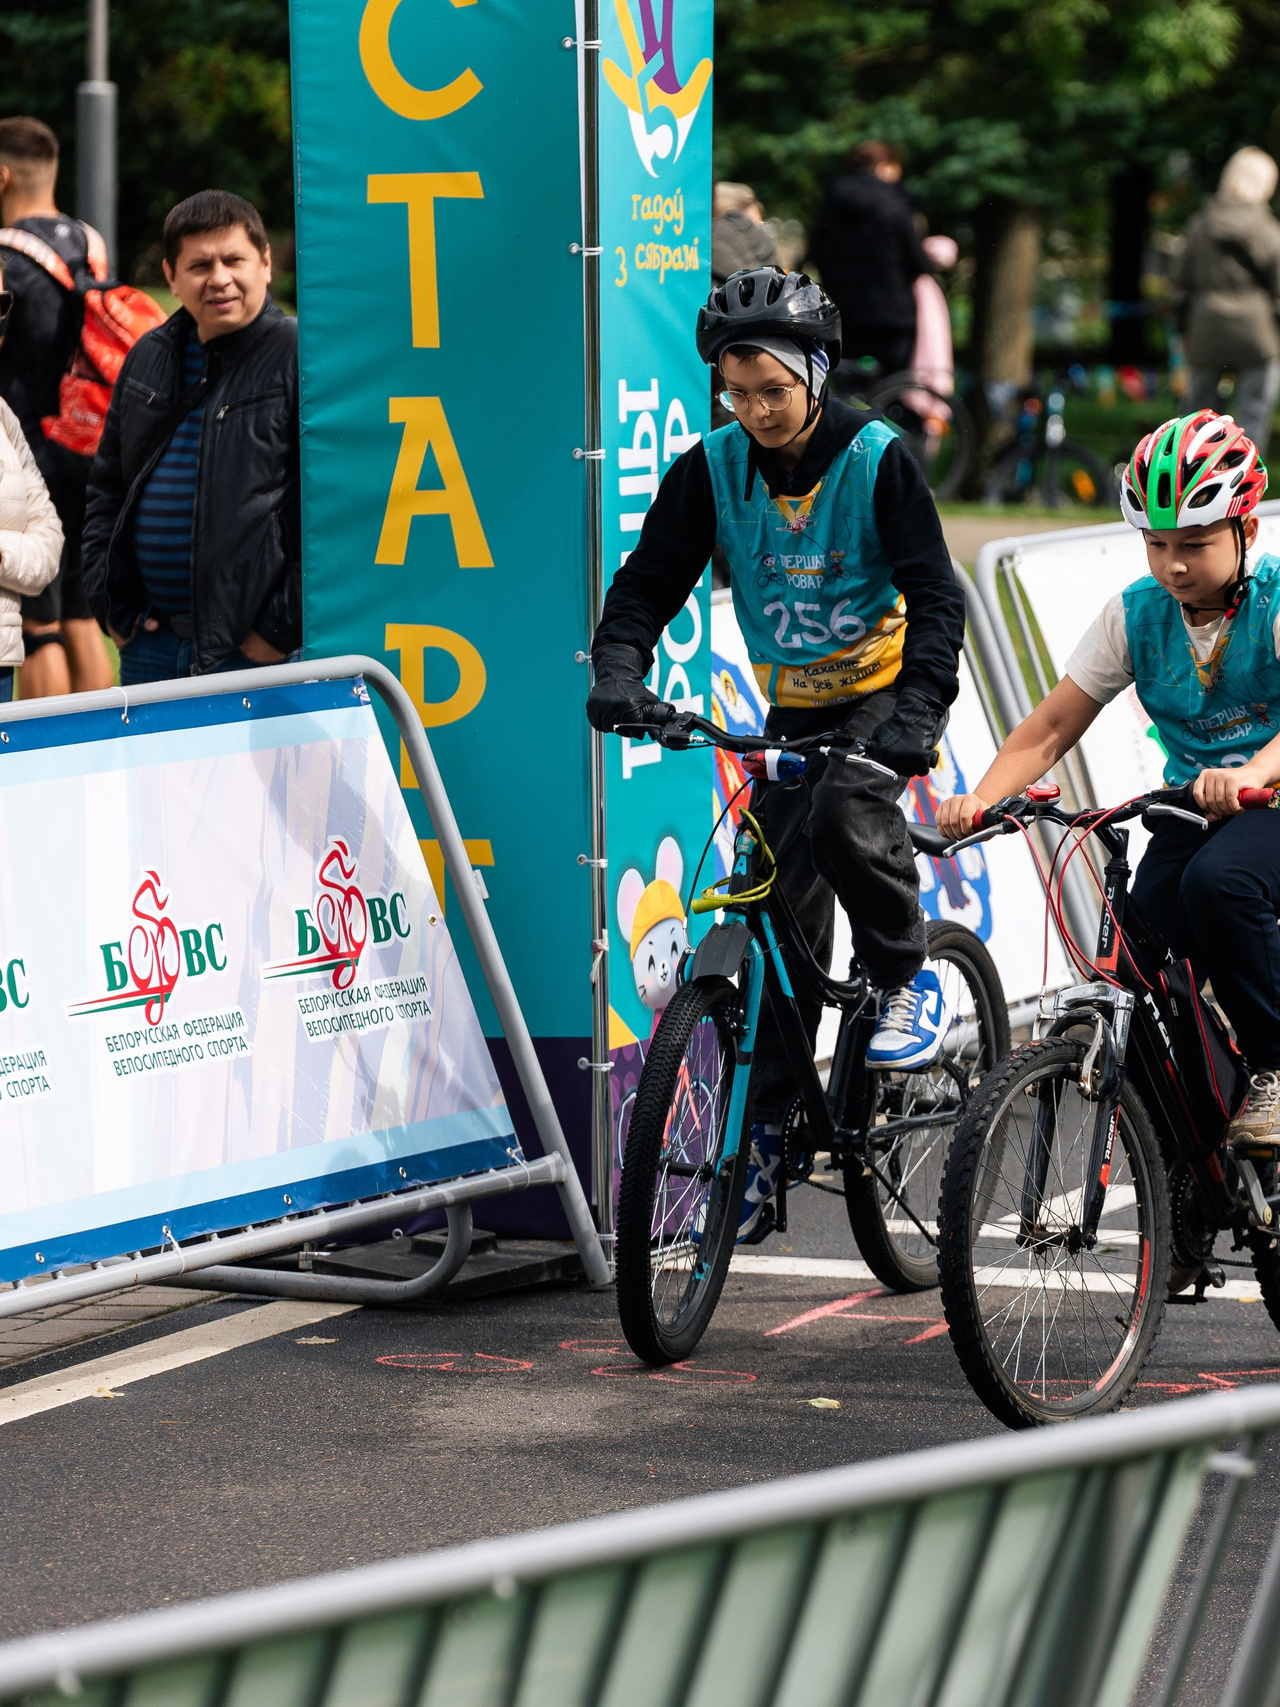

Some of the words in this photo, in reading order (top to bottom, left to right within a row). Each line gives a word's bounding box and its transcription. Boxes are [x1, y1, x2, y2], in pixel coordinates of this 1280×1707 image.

[779, 554, 827, 570] ПЕРШЫ
[785, 573, 825, 590] РОВАР
[763, 598, 866, 648] 256
[1197, 704, 1251, 732] ПЕРШЫ
[1208, 723, 1253, 743] РОВАР
[297, 986, 372, 1015] БЕЛОРУССКАЯ
[374, 976, 428, 1002] ФЕДЕРАЦИЯ
[105, 1023, 181, 1053] БЕЛОРУССКАЯ
[182, 1011, 245, 1038] ФЕДЕРАЦИЯ
[305, 1005, 394, 1038] ВЕЛОСИПЕДНОГО
[396, 999, 432, 1019] СПОРТА
[113, 1044, 205, 1077] ВЕЛОСИПЕДНОГО
[206, 1035, 249, 1058] СПОРТА
[6, 1075, 52, 1099] СПОРТА
[1104, 1115, 1116, 1160] Racer
